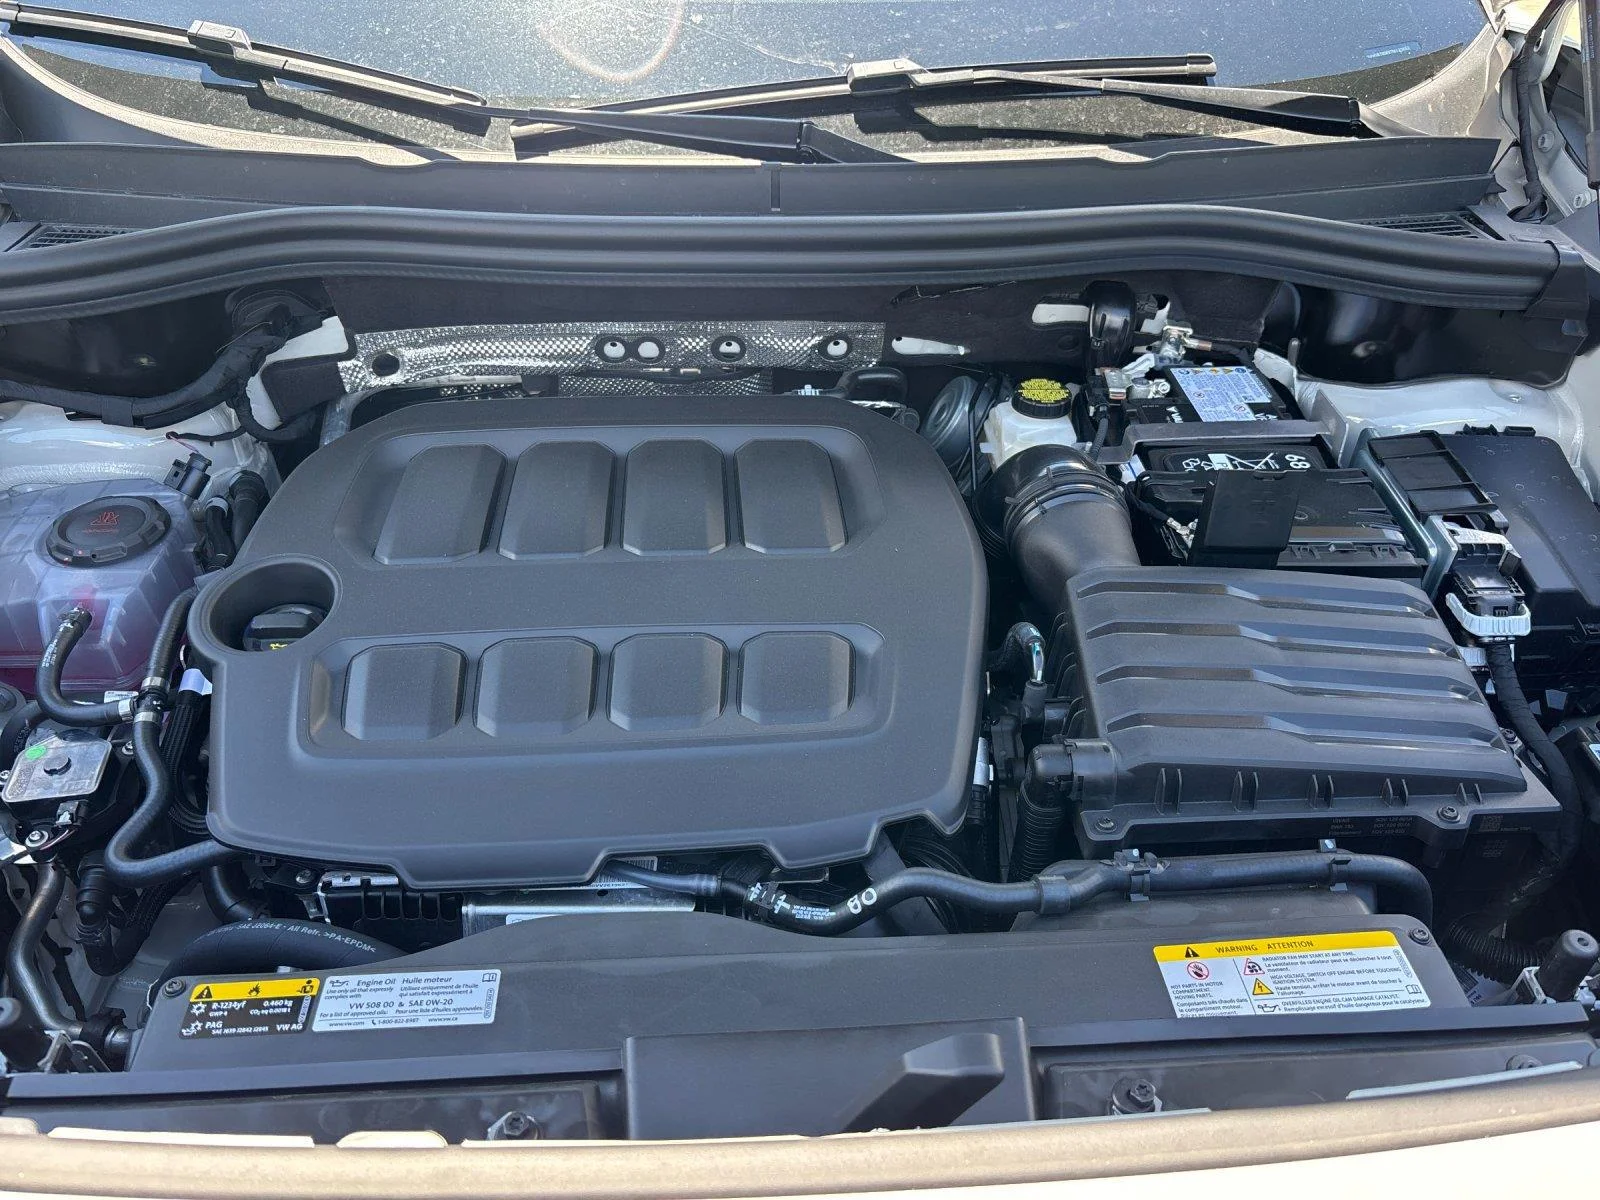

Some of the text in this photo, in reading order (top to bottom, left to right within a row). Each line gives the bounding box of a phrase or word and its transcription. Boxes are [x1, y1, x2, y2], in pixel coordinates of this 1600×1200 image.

[1216, 940, 1314, 953] WARNING ATTENTION
[212, 1000, 246, 1010] R-1234yf
[284, 1000, 293, 1008] kg
[426, 998, 454, 1006] 0W-20
